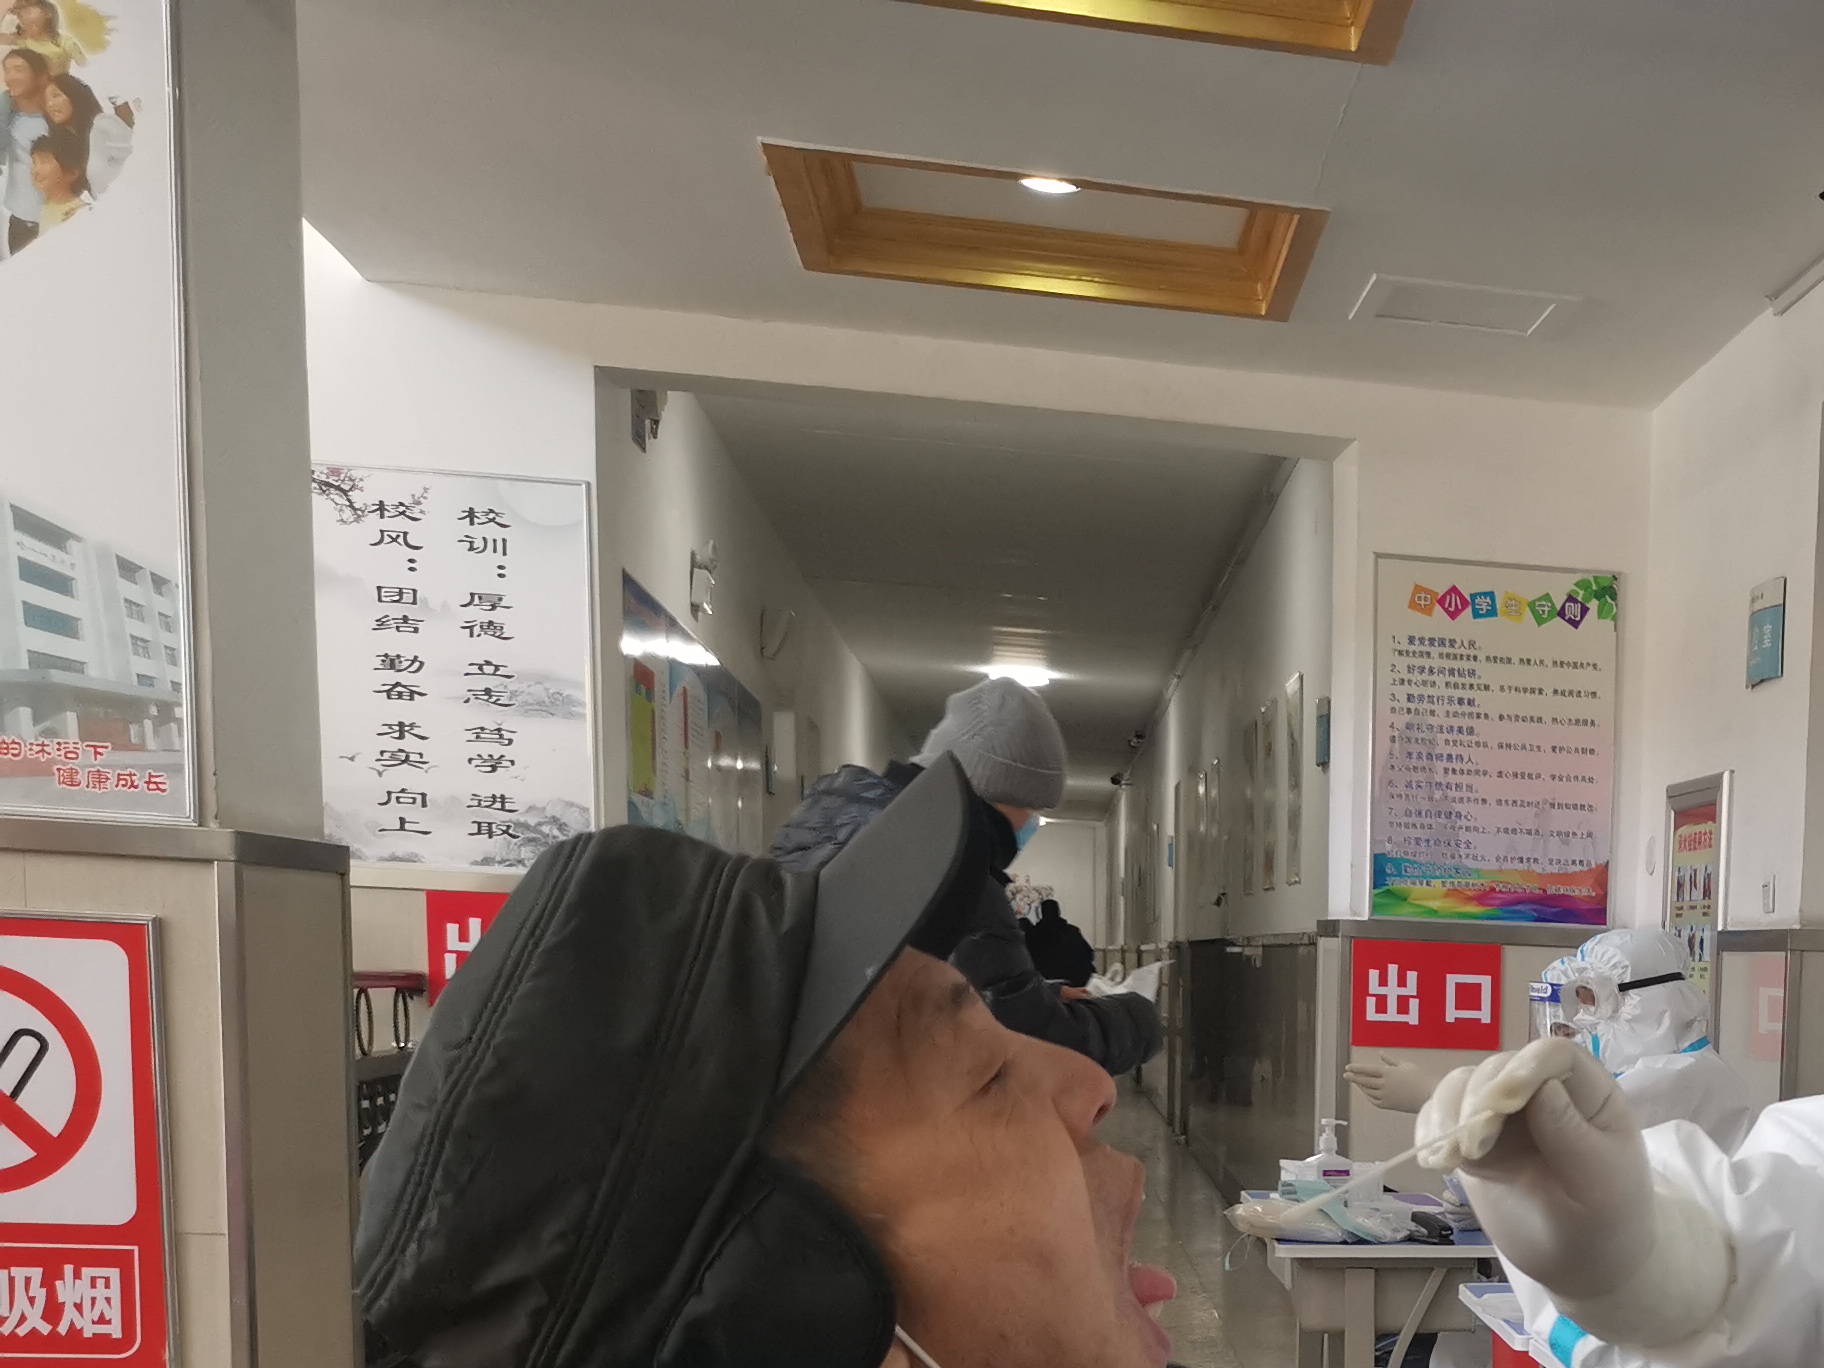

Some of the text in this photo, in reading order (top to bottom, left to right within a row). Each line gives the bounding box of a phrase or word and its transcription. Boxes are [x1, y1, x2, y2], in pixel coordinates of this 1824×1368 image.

[1412, 589, 1583, 623] 中小学生守则
[56, 766, 169, 794] 健康成长
[1364, 964, 1494, 1027] 出口
[0, 1265, 124, 1340] 吸烟
